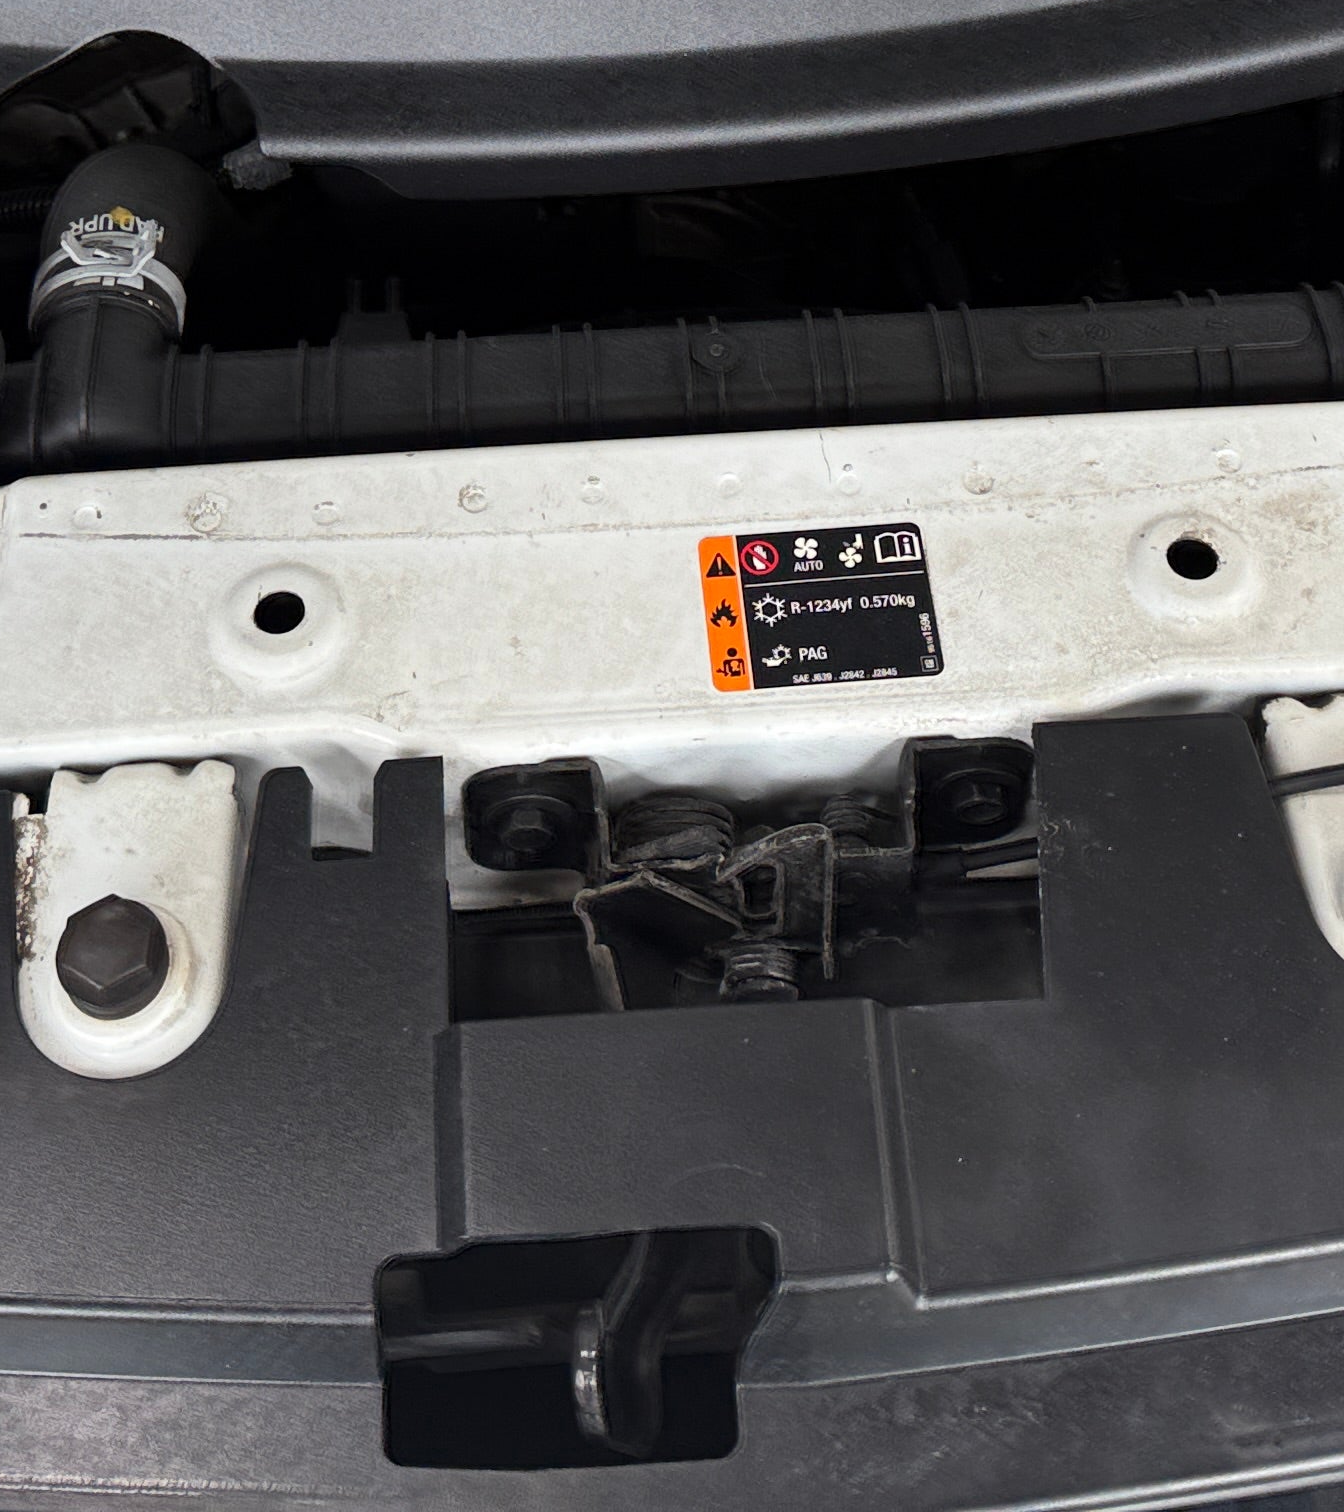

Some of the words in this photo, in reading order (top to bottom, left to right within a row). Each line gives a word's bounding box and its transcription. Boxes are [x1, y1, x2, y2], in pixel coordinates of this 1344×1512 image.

[67, 213, 114, 236] UPR
[793, 560, 824, 573] AUTO
[791, 596, 853, 615] R-1234yf
[859, 595, 916, 611] 0.570kg
[798, 646, 828, 662] PAG
[792, 674, 810, 684] SAE
